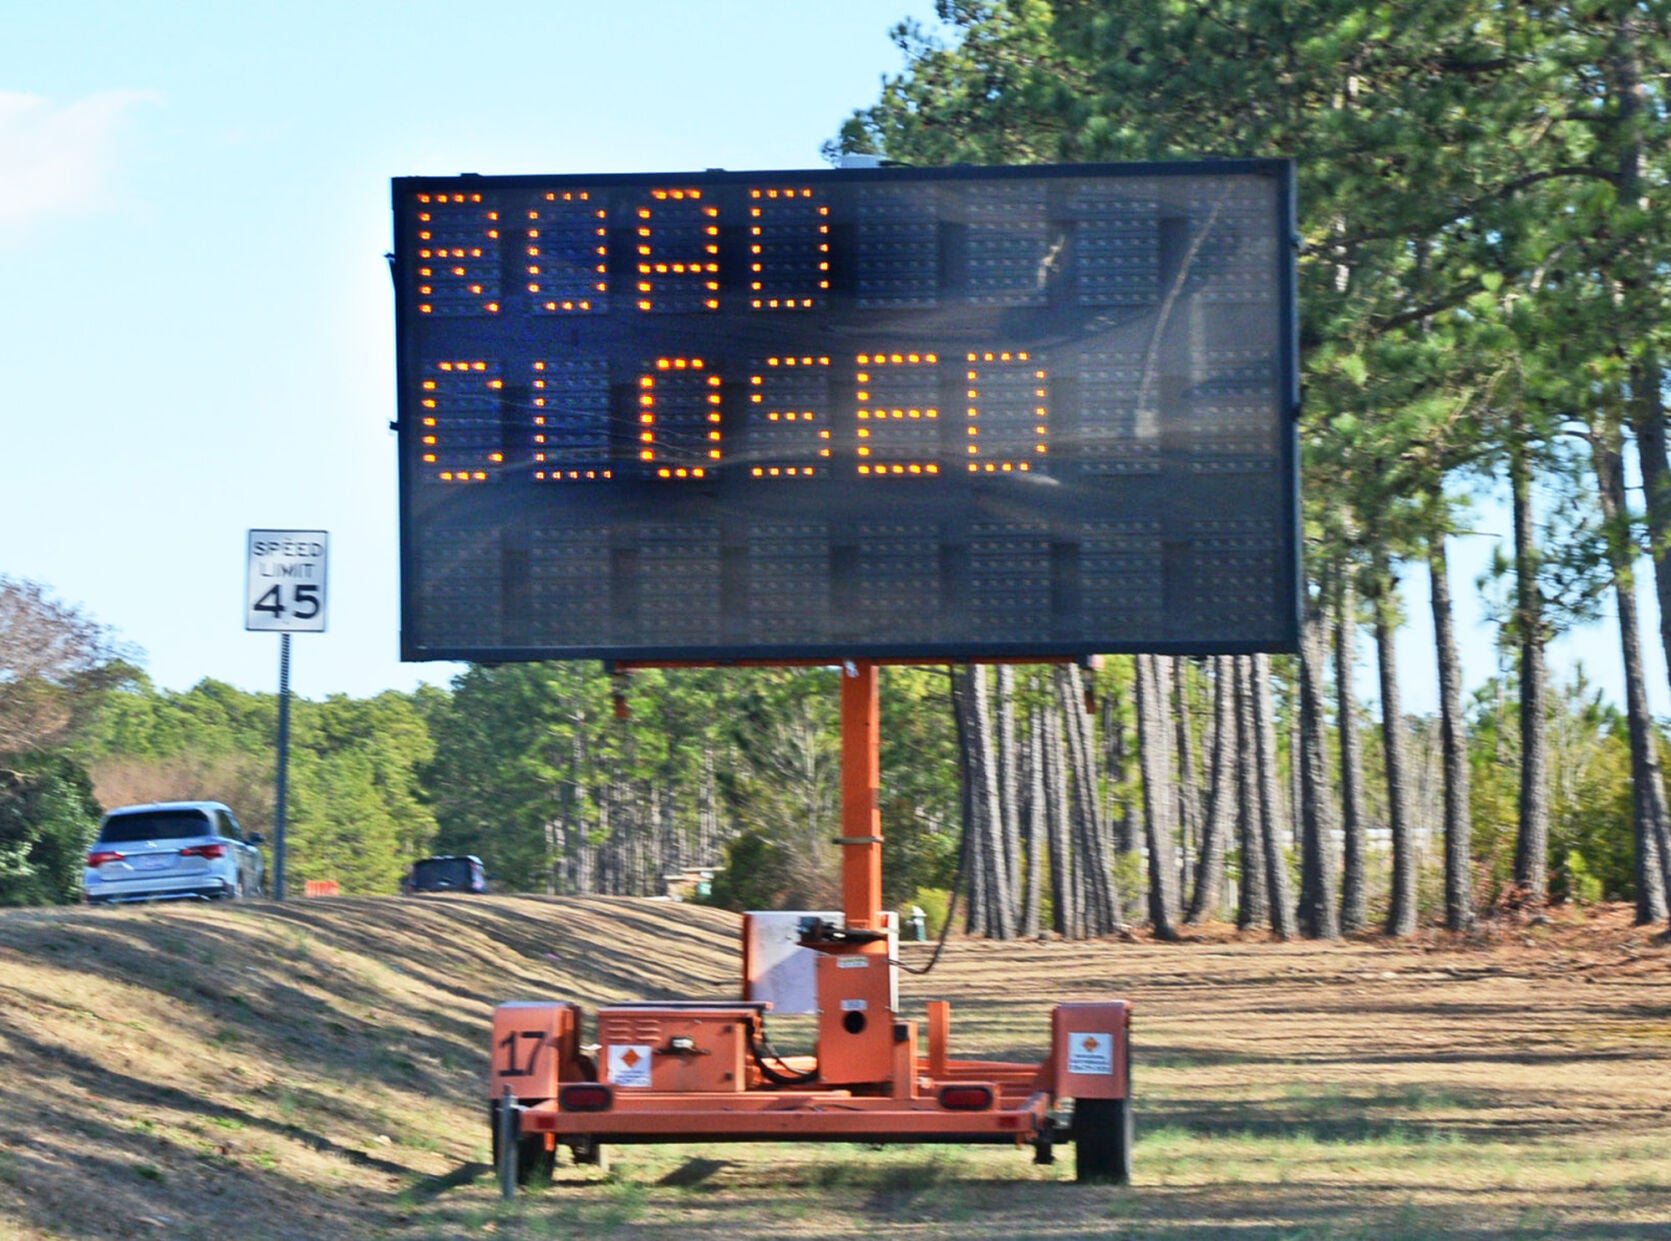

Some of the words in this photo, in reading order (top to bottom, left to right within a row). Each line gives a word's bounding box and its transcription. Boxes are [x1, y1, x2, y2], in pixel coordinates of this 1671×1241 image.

[418, 188, 829, 313] ROAD
[421, 351, 1048, 482] CLOSED
[253, 541, 324, 557] SPEED
[259, 562, 315, 578] LIMIT
[253, 584, 320, 619] 45
[499, 1030, 546, 1077] 17
